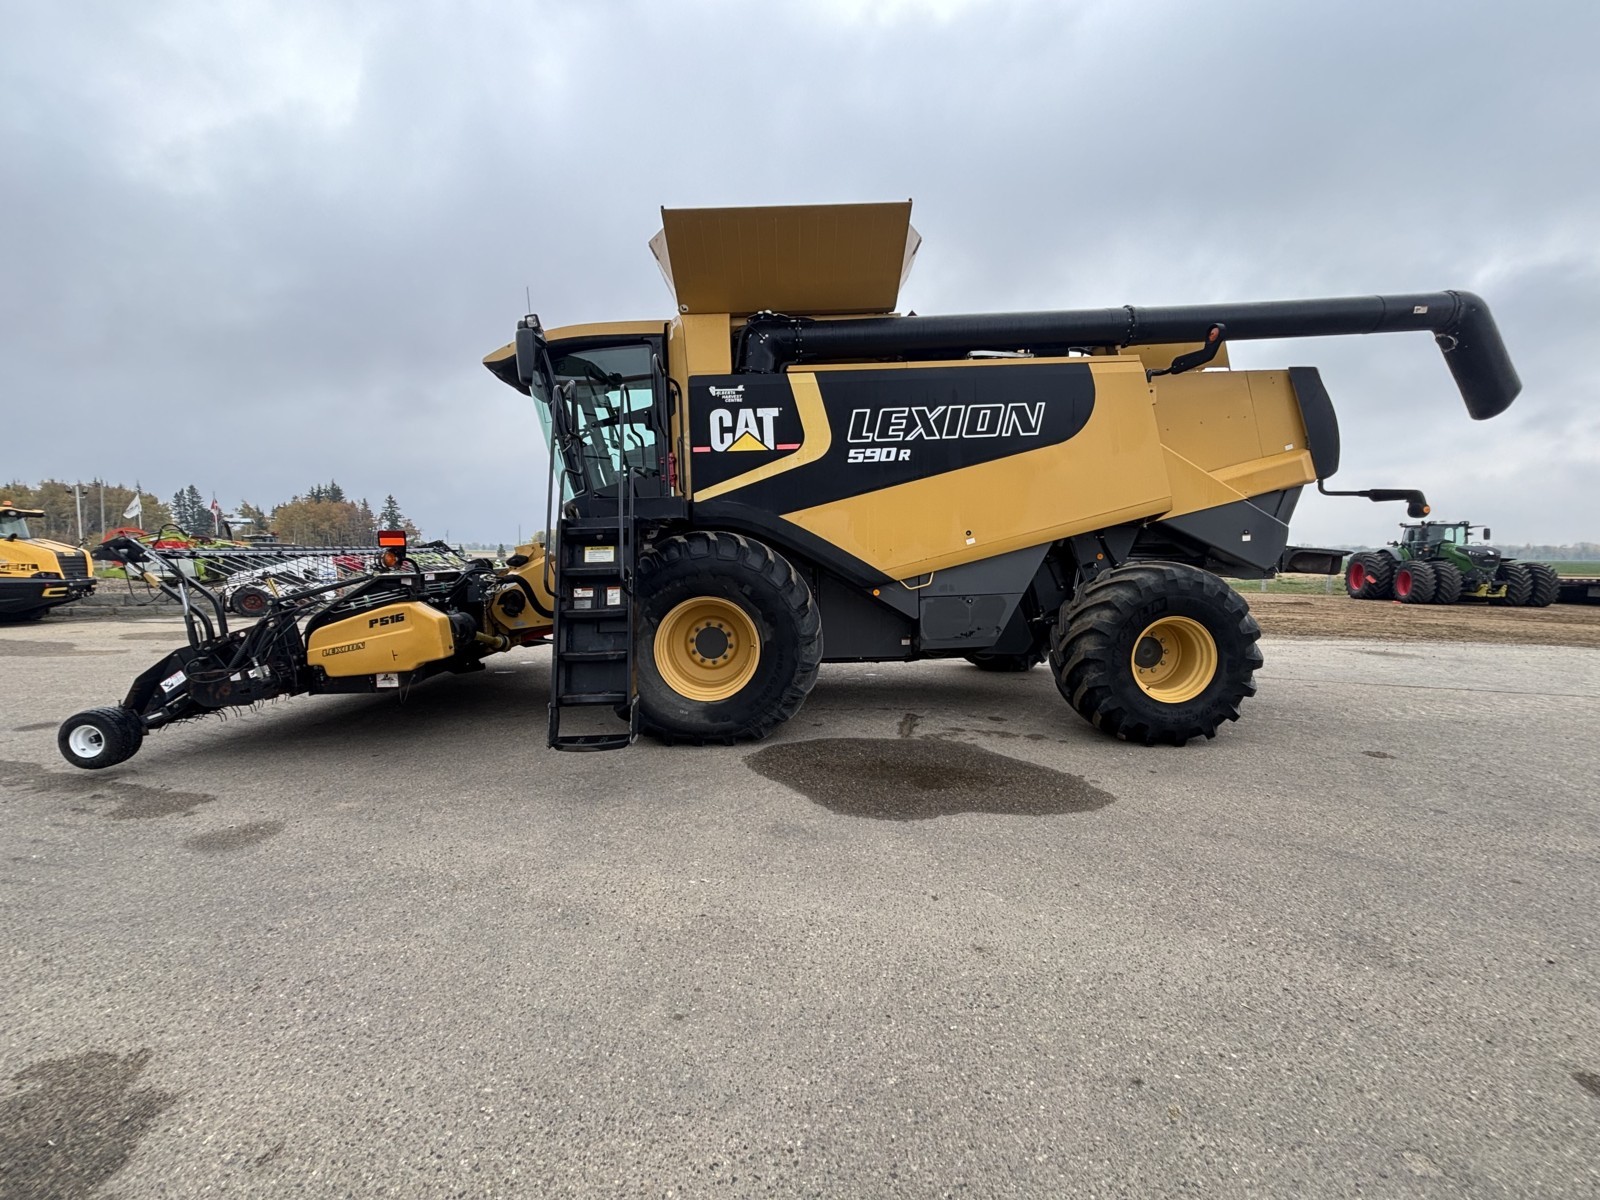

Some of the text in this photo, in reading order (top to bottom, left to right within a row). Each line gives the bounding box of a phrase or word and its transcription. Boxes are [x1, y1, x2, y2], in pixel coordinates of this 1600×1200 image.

[709, 407, 779, 452] CAT
[847, 402, 1046, 443] LEXION
[847, 447, 911, 463] 590 R
[368, 612, 405, 629] P516
[321, 641, 366, 657] LEXION
